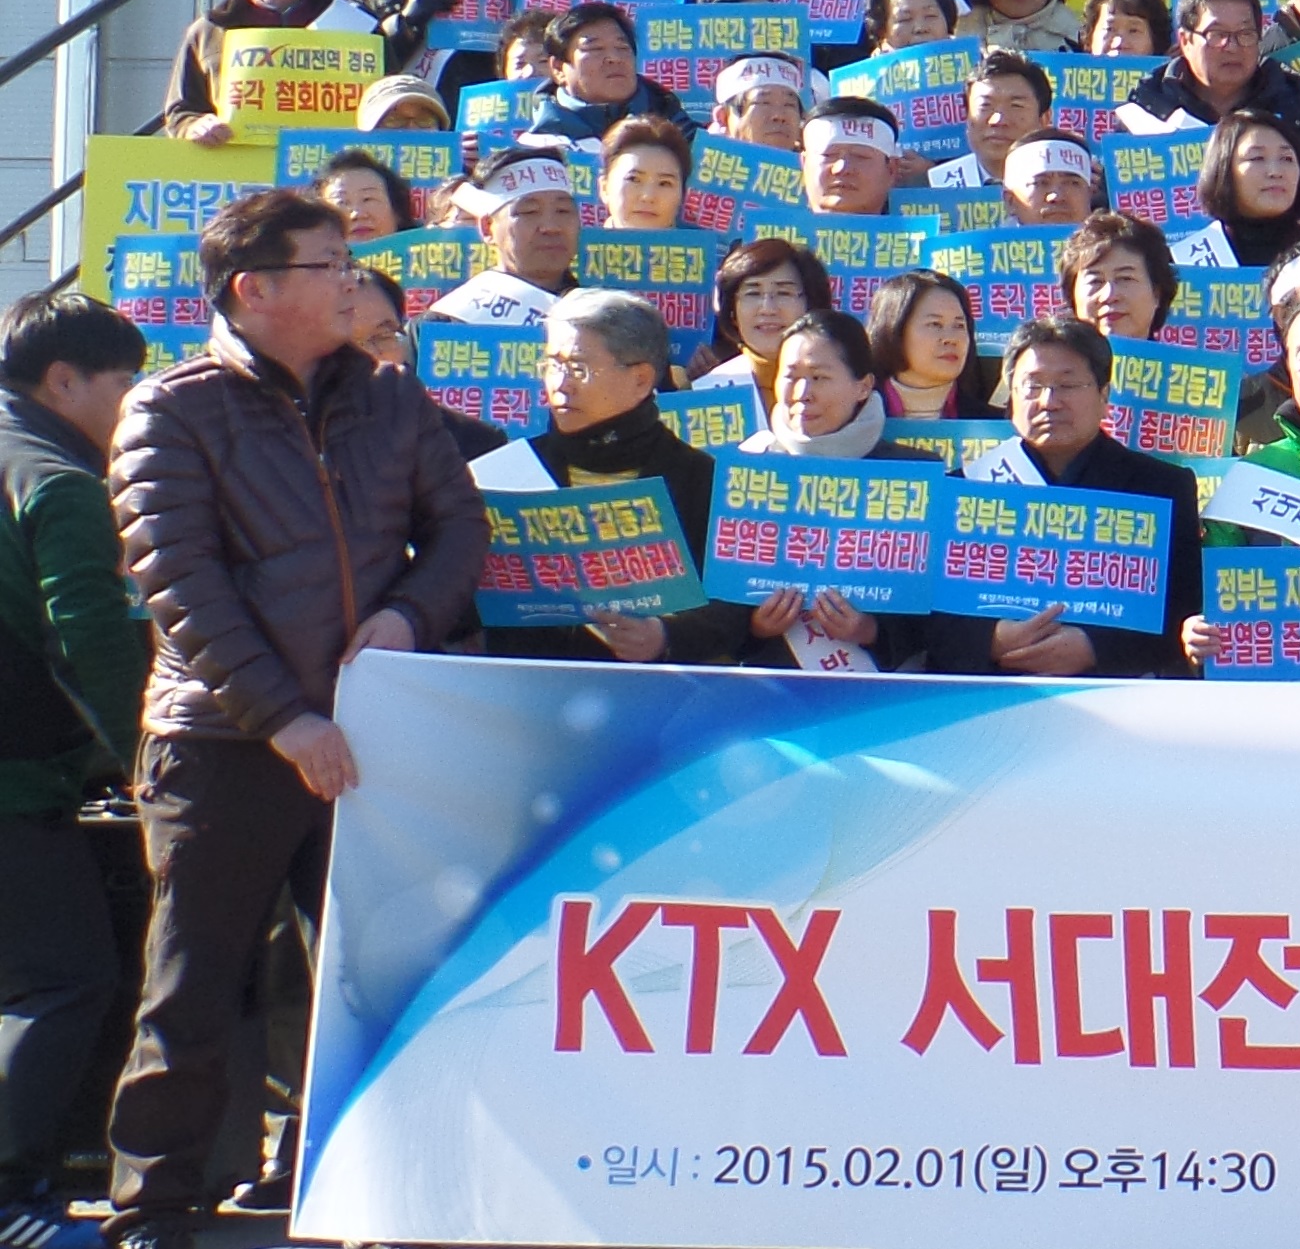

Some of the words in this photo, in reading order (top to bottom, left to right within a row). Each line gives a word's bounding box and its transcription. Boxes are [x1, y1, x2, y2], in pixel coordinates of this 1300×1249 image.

[231, 43, 289, 68] KTX
[280, 47, 341, 71] 서대전역
[348, 50, 377, 74] 경유
[842, 119, 875, 140] 반대
[727, 466, 789, 509] 정부는
[795, 474, 859, 518] 지역간
[867, 480, 929, 521] 갈등과
[519, 507, 588, 543] 지역간
[588, 498, 662, 539] 갈등과
[1217, 568, 1277, 610] 정부는
[552, 901, 849, 1058] KTX
[713, 1145, 1048, 1194] 2015.02.01(일)
[1059, 1148, 1277, 1194] 오후14:30
